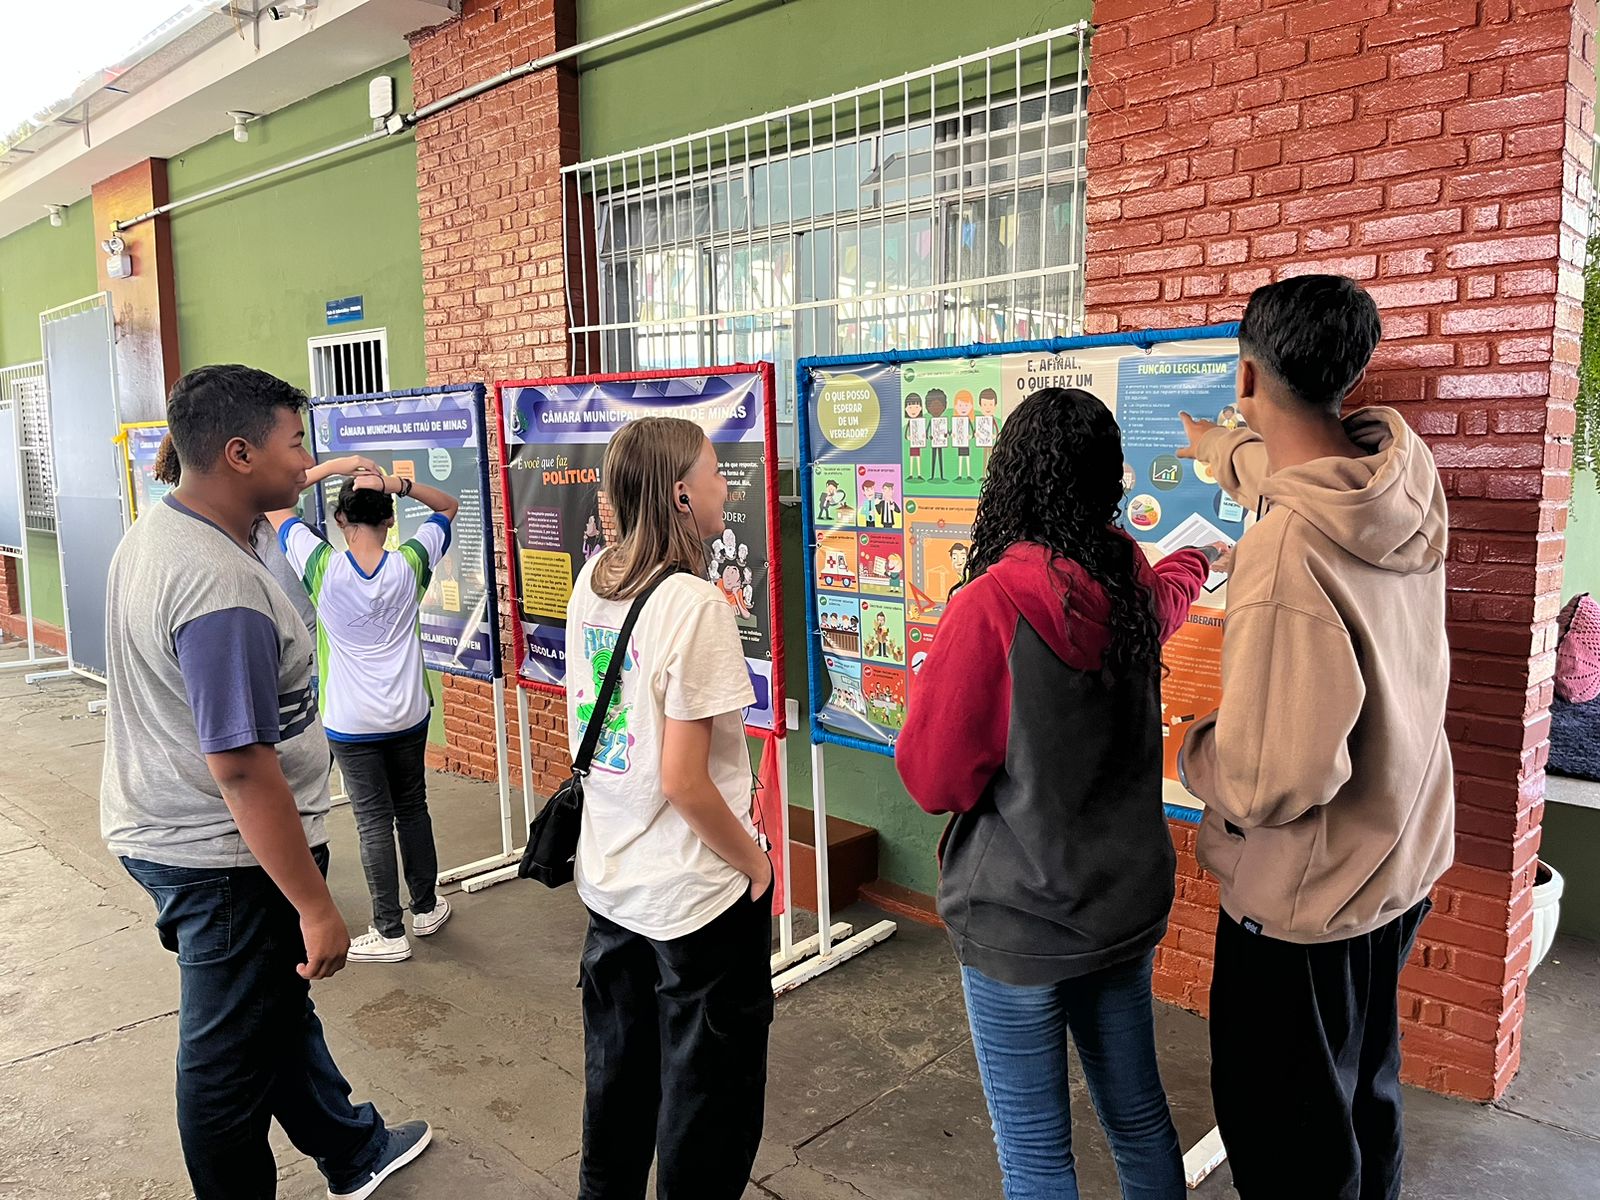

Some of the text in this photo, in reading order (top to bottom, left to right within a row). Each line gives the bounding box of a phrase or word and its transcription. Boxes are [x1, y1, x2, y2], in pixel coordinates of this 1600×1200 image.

[1027, 356, 1081, 373] E, AFINAL,
[1137, 361, 1227, 375] FUNÇÃO LEGISLATIVA
[1016, 374, 1093, 391] O QUE FAZ UM
[824, 389, 870, 403] O QUE POSSO
[541, 409, 581, 424] CÂMARA
[583, 409, 640, 423] MUNICIPAL
[691, 408, 705, 421] DE
[708, 405, 747, 420] MINAS
[833, 402, 863, 414] ESPERAR
[340, 419, 468, 437] CÂMARA MUNICIPAL DE ITAÚ DE MINAS
[838, 416, 859, 426] DE UM
[829, 428, 869, 439] VEREADOR?
[524, 456, 540, 469] você
[541, 457, 554, 470] que
[556, 454, 568, 470] faz
[542, 467, 601, 486] POLÍTICA!
[421, 632, 458, 647] ARLAMENTO
[530, 643, 557, 660] ESCOLA
